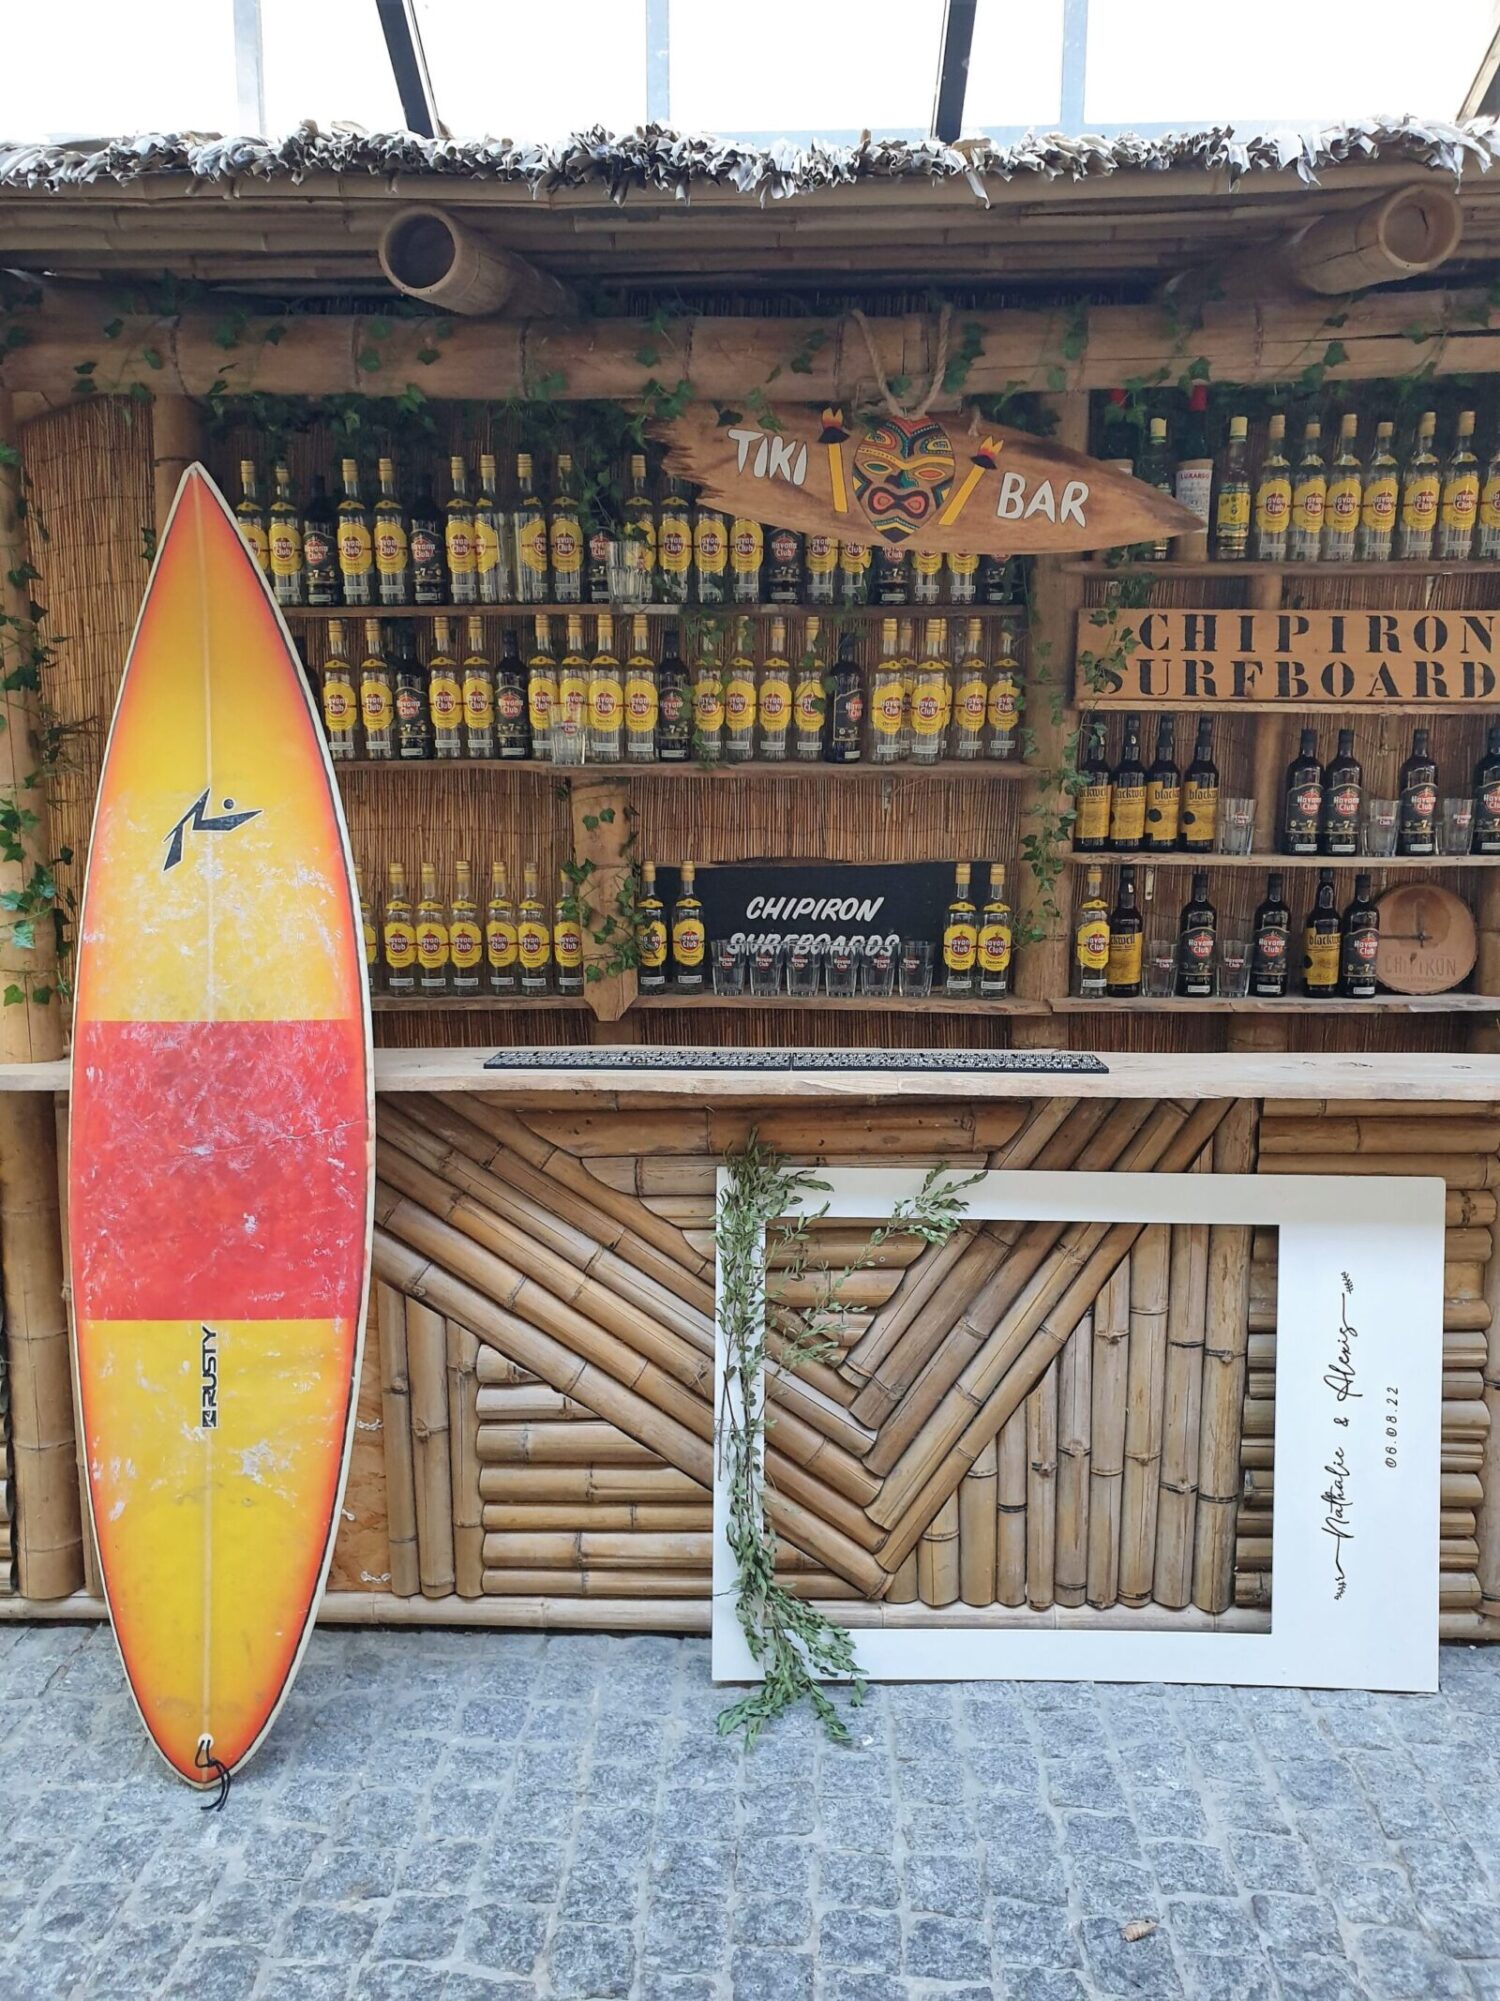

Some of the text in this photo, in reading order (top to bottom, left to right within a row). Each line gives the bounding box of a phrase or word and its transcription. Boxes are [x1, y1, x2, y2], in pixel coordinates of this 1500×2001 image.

[727, 428, 808, 486] TIKI
[997, 472, 1090, 528] BAR
[776, 549, 792, 557] Club
[1138, 613, 1496, 654] CHIPIRON
[1095, 658, 1496, 699] SURFBOARD
[503, 706, 518, 714] Club
[1303, 803, 1318, 811] Club
[1339, 803, 1354, 811] Club
[1416, 803, 1432, 811] Club
[1306, 820, 1313, 828] 7
[1343, 820, 1350, 828] 7
[1421, 820, 1428, 828] 7
[1494, 818, 1500, 826] 7
[746, 896, 884, 922] CHIPIRON
[682, 940, 697, 949] Club
[726, 933, 900, 956] SURFBOARDS
[953, 944, 968, 953] Club
[1089, 943, 1104, 951] Club
[989, 945, 1004, 953] Club
[1194, 946, 1209, 954] Club
[1198, 962, 1204, 971] 7
[1364, 963, 1370, 971] 7
[202, 1326, 217, 1407] RUSTY
[1385, 1386, 1399, 1468] 06.08.22
[1321, 1326, 1363, 1538] Nathalie & Alexis
